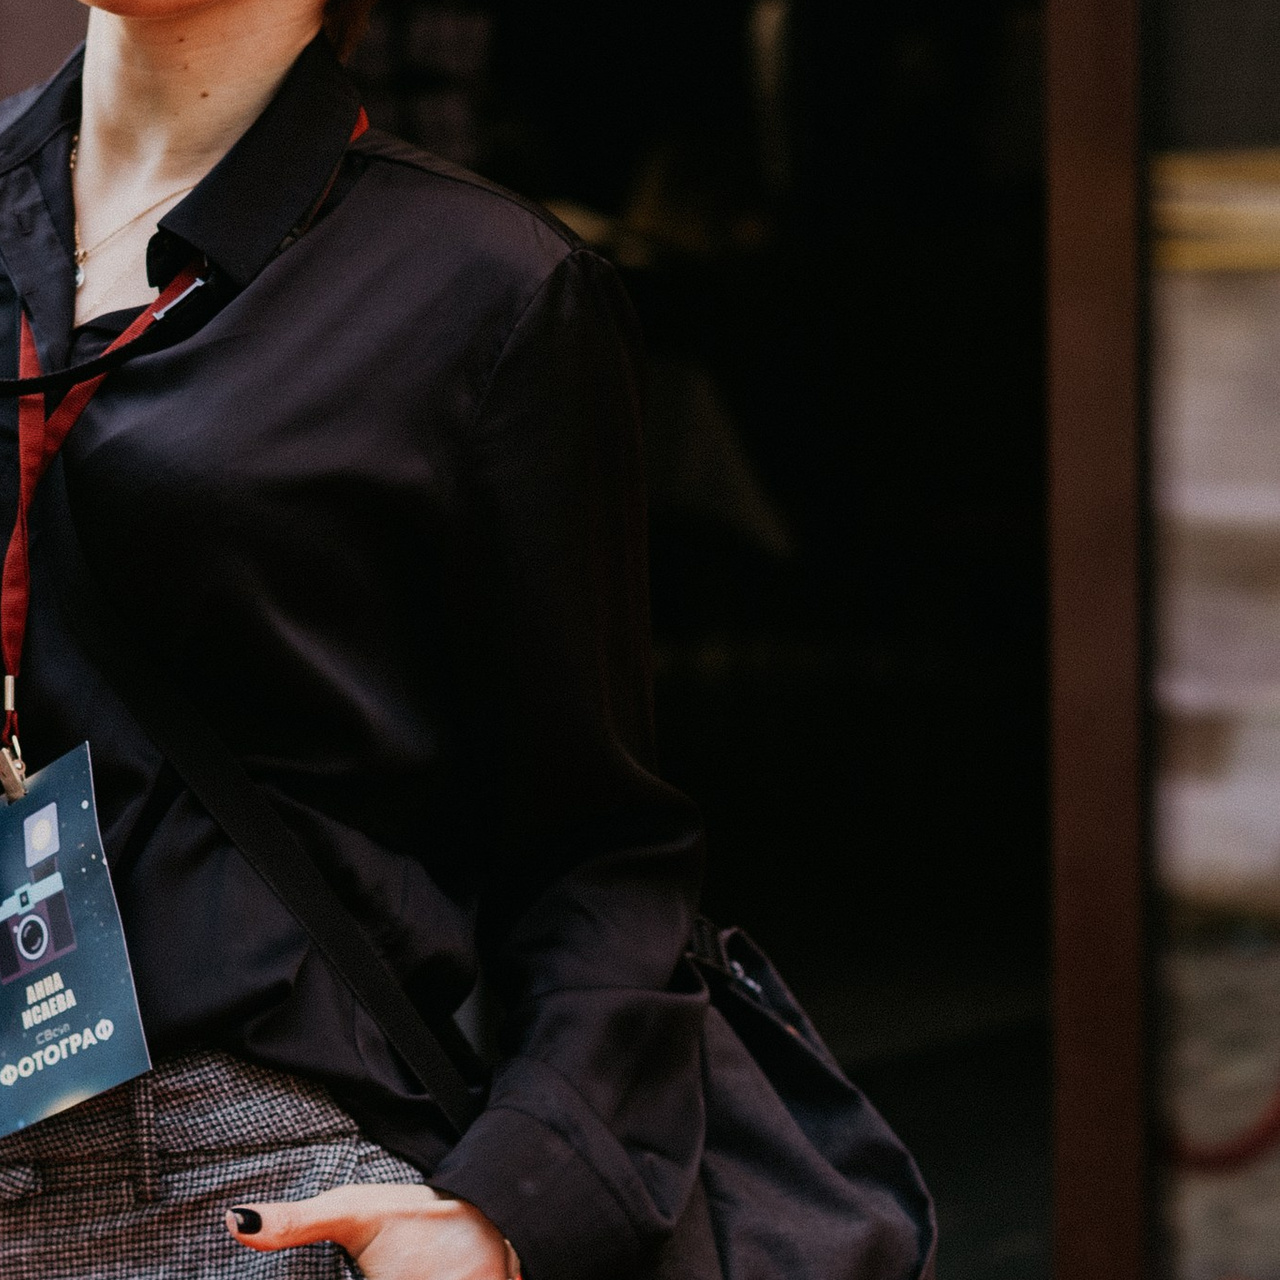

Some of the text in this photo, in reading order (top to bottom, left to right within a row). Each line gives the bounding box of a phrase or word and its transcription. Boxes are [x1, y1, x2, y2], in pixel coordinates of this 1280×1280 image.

[21, 988, 77, 1030] ИСАЕВА
[25, 972, 65, 1005] АННА
[0, 1018, 114, 1086] ФОТОГРАФ
